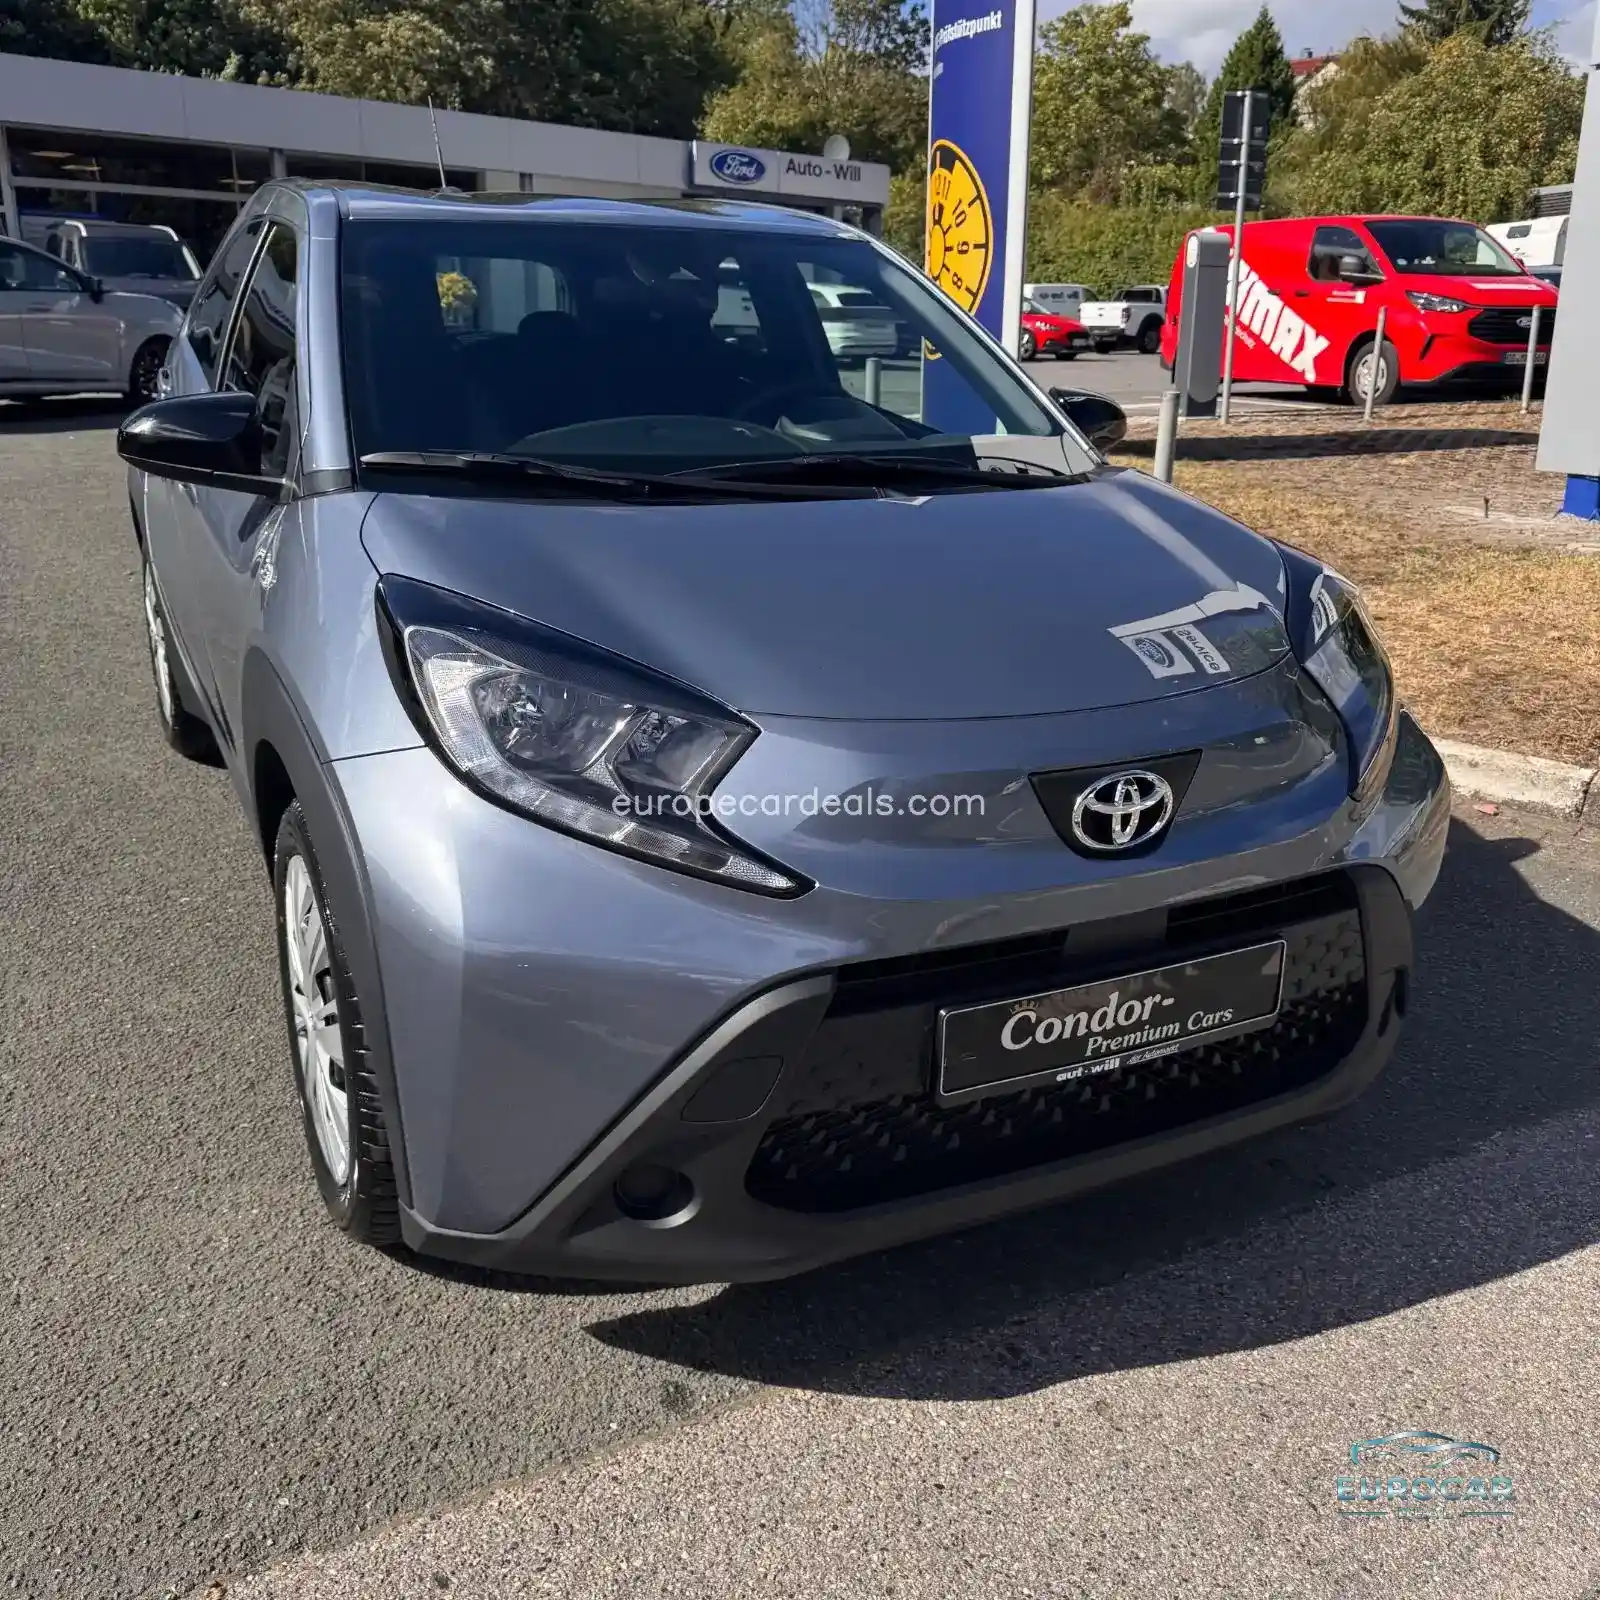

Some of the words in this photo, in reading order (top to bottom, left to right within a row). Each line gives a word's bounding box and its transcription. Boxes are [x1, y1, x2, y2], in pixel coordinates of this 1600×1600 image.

[723, 154, 757, 178] Ford
[951, 272, 963, 290] 8
[1084, 1021, 1181, 1057] Premium
[1187, 1006, 1234, 1031] Cars
